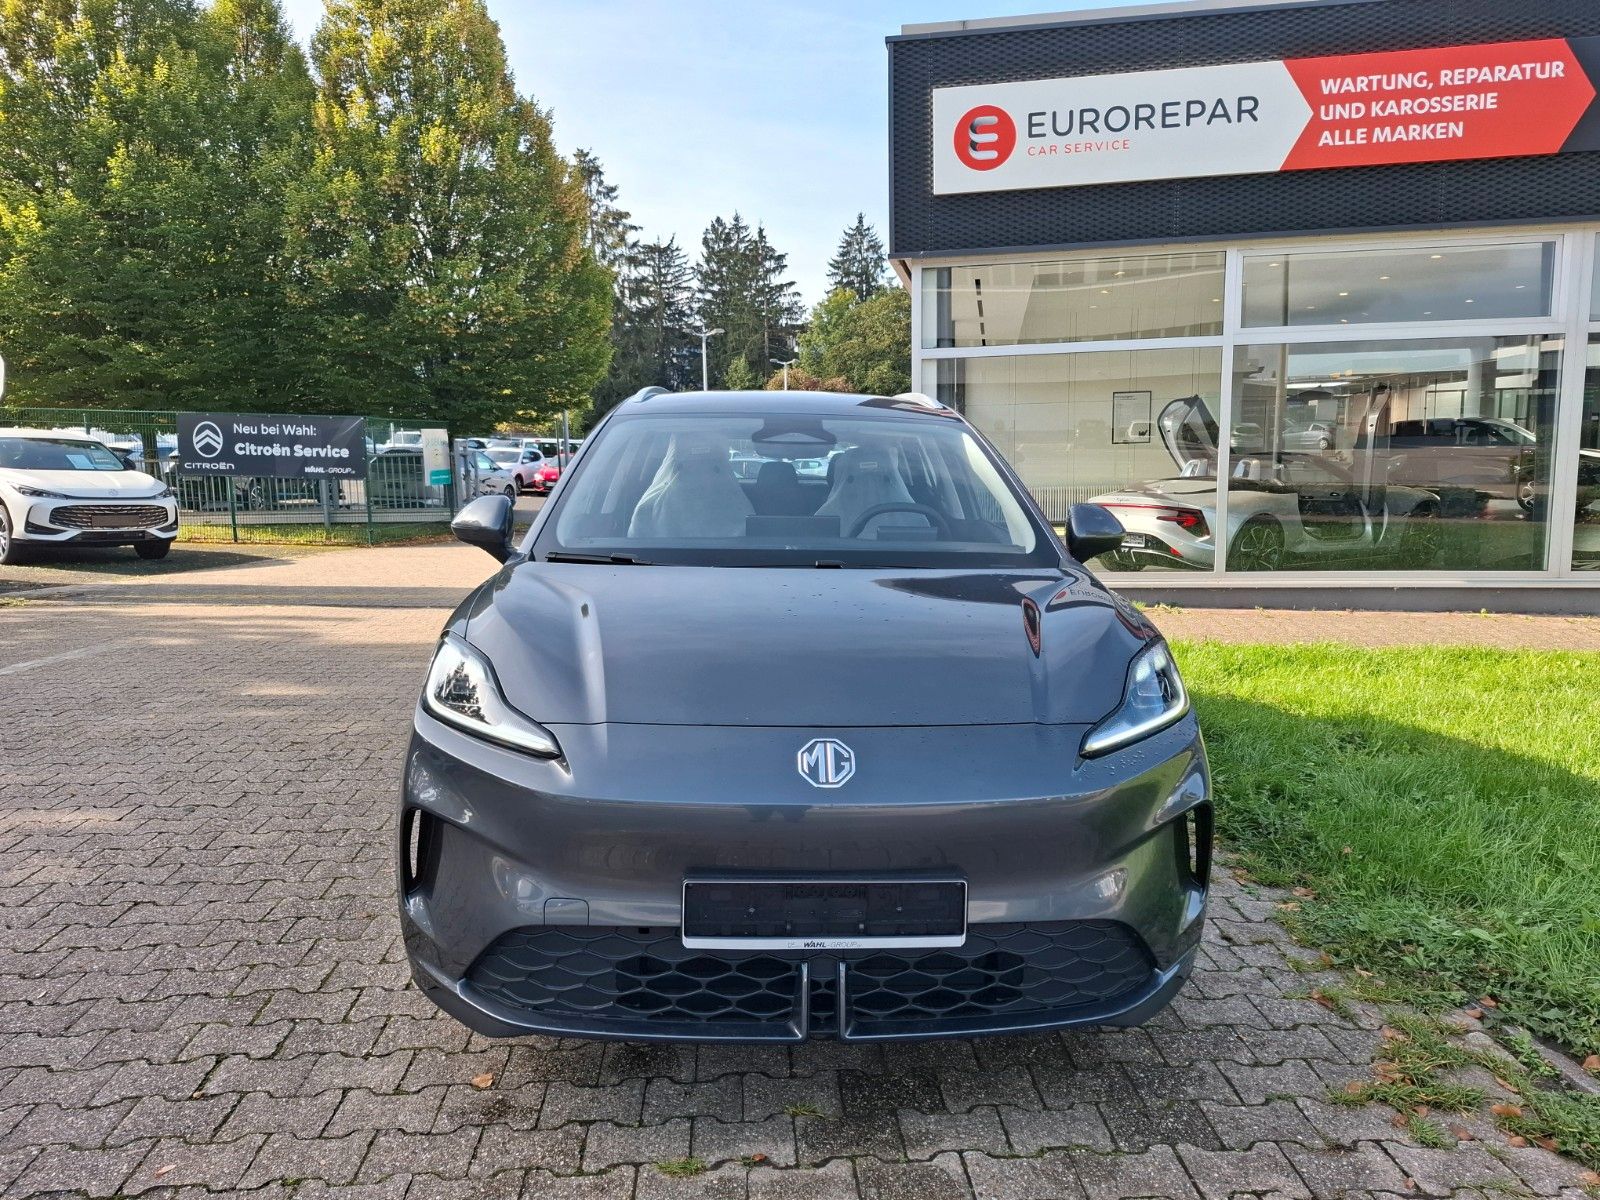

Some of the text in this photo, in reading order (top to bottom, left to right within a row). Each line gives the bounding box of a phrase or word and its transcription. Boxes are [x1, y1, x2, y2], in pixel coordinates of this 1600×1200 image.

[1320, 61, 1565, 95] WARTUNG, REPARATUR
[1027, 95, 1260, 138] EUROREPAR
[1320, 92, 1499, 121] UND KAROSSERIE
[1027, 139, 1131, 156] CAR SERVICE
[1317, 121, 1464, 147] ALLE MARKEN
[233, 423, 317, 436] Neu bei Wahl:
[234, 442, 350, 458] Citroën Service
[803, 742, 850, 783] MG
